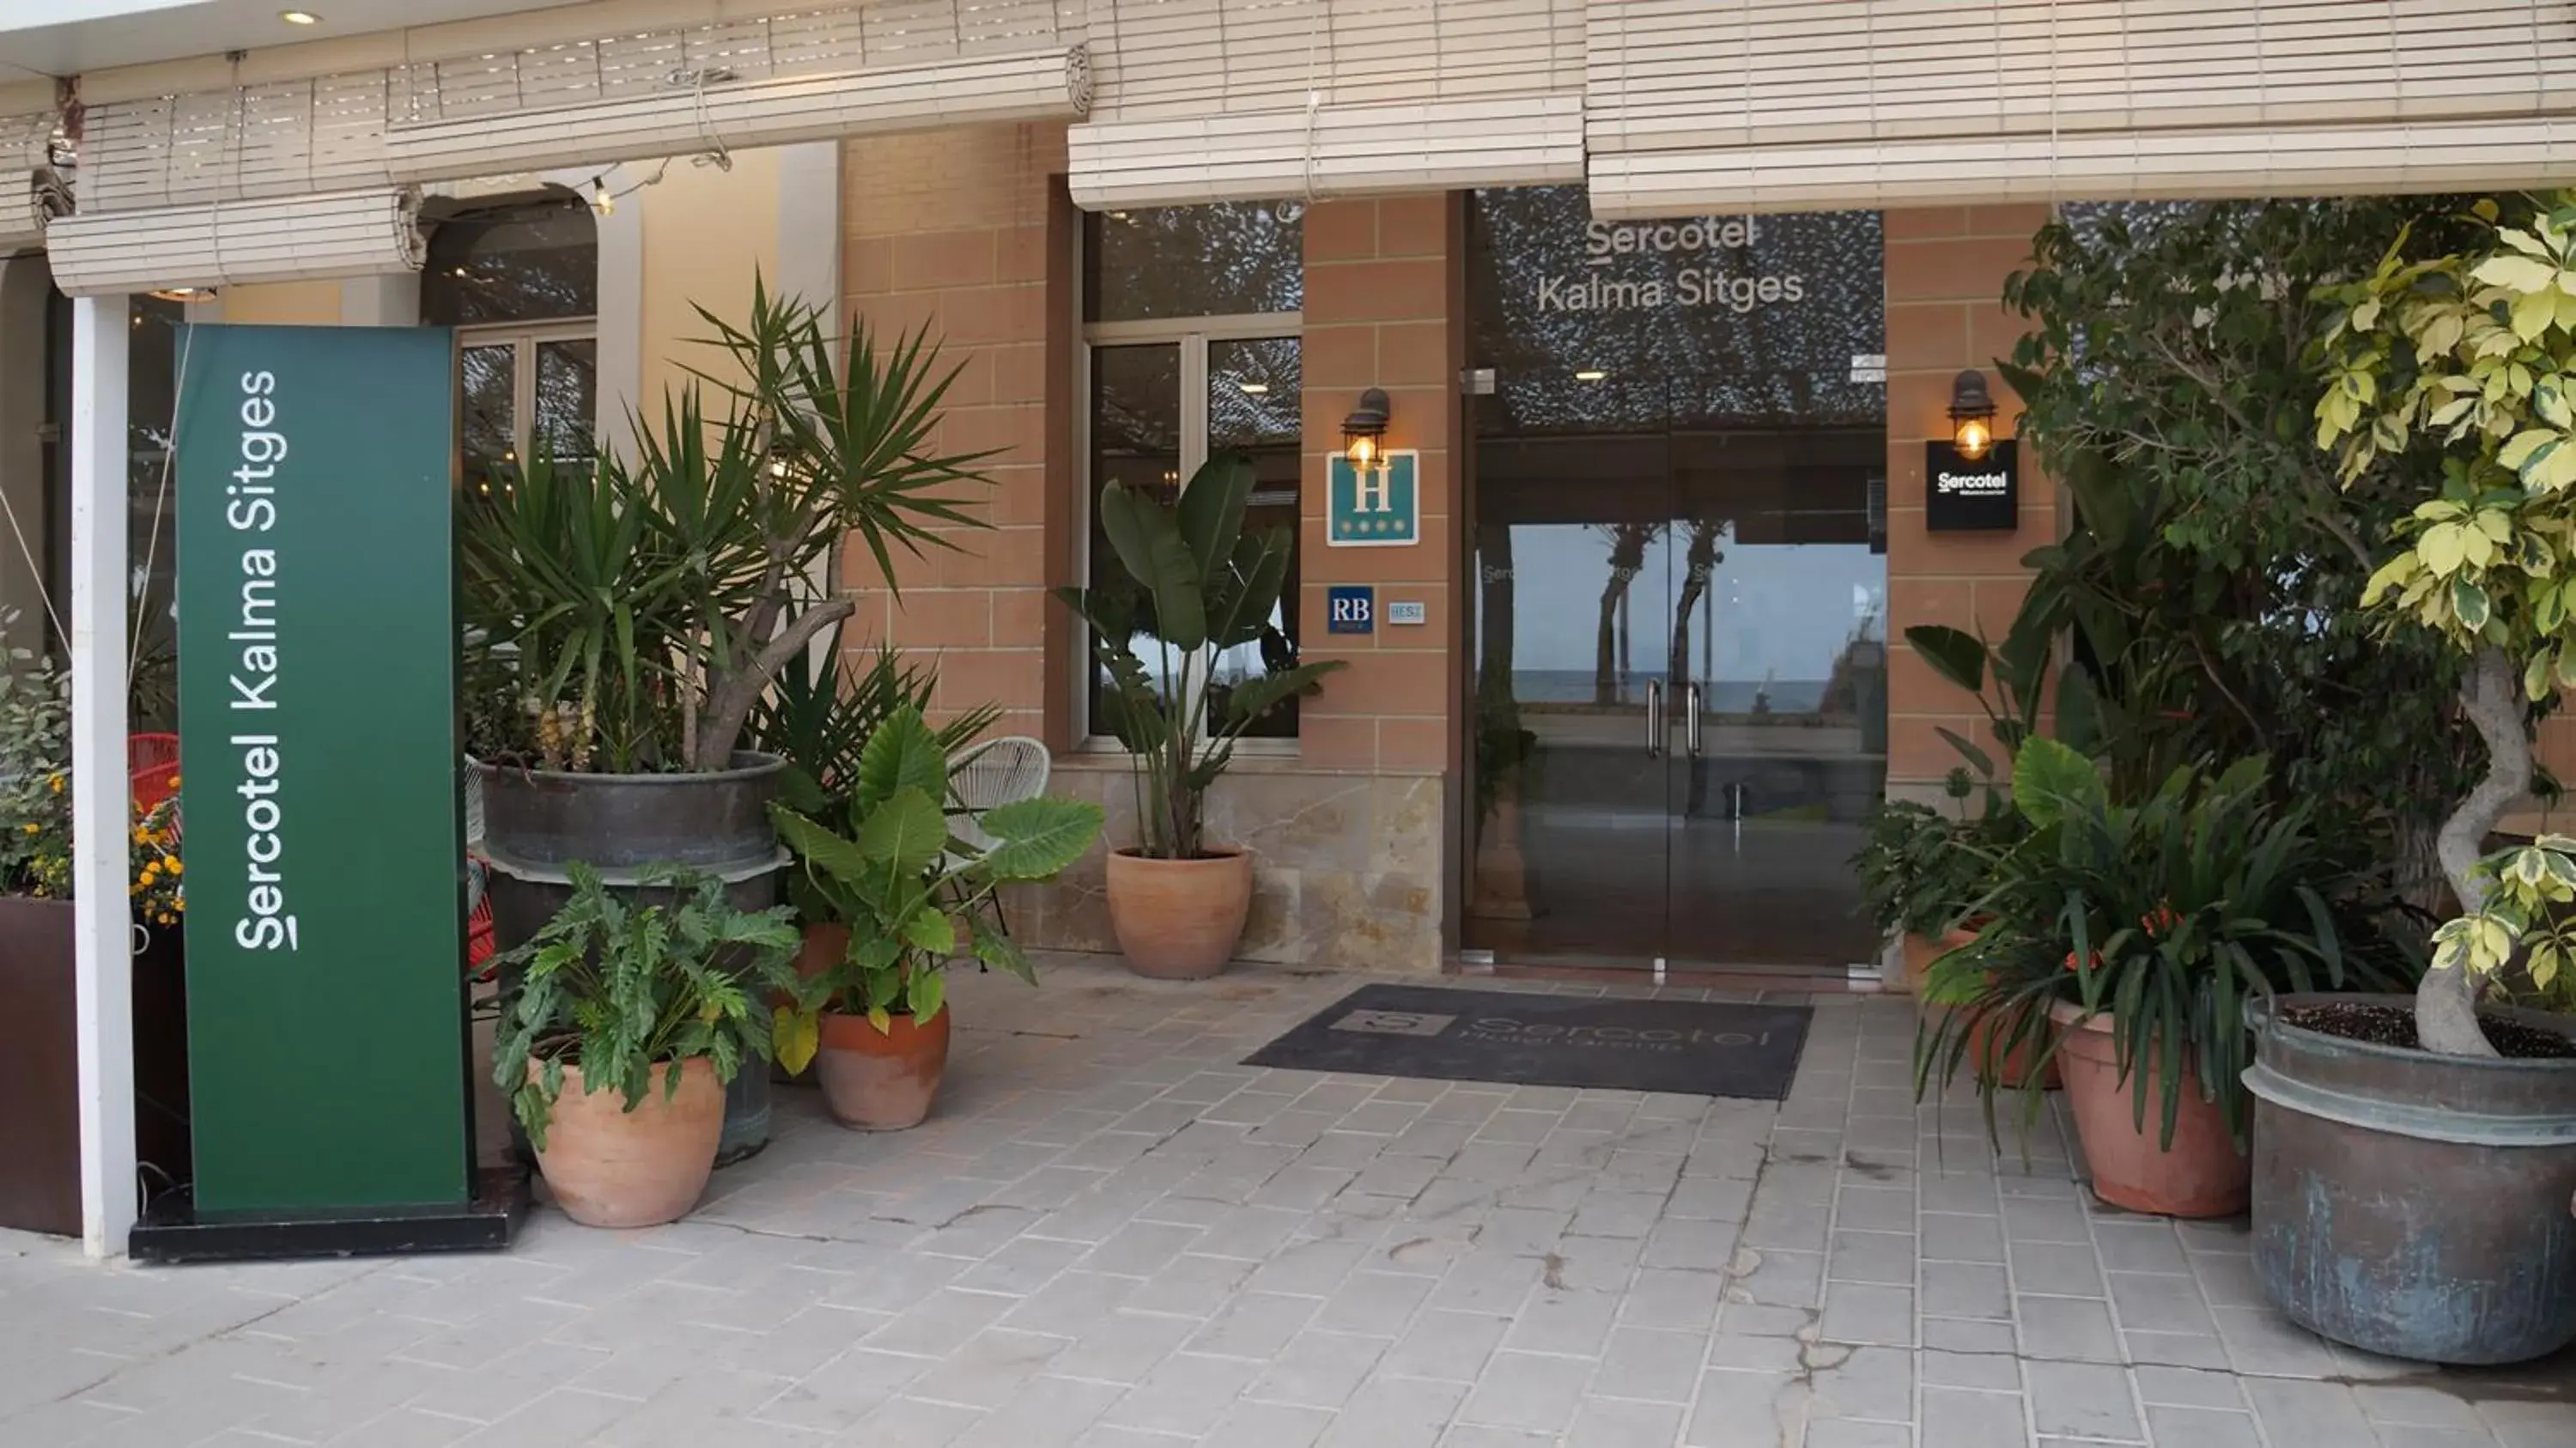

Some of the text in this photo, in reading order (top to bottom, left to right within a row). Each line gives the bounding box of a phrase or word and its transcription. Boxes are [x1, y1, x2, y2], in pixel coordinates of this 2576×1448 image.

[1586, 215, 1754, 265] Sercotel
[1538, 267, 1803, 313] Kalma Sitges
[1353, 464, 1392, 513] H
[1937, 471, 2007, 491] Sercotel
[1334, 599, 1370, 621] RB
[227, 370, 297, 951] Sercotel Kalma Sitges
